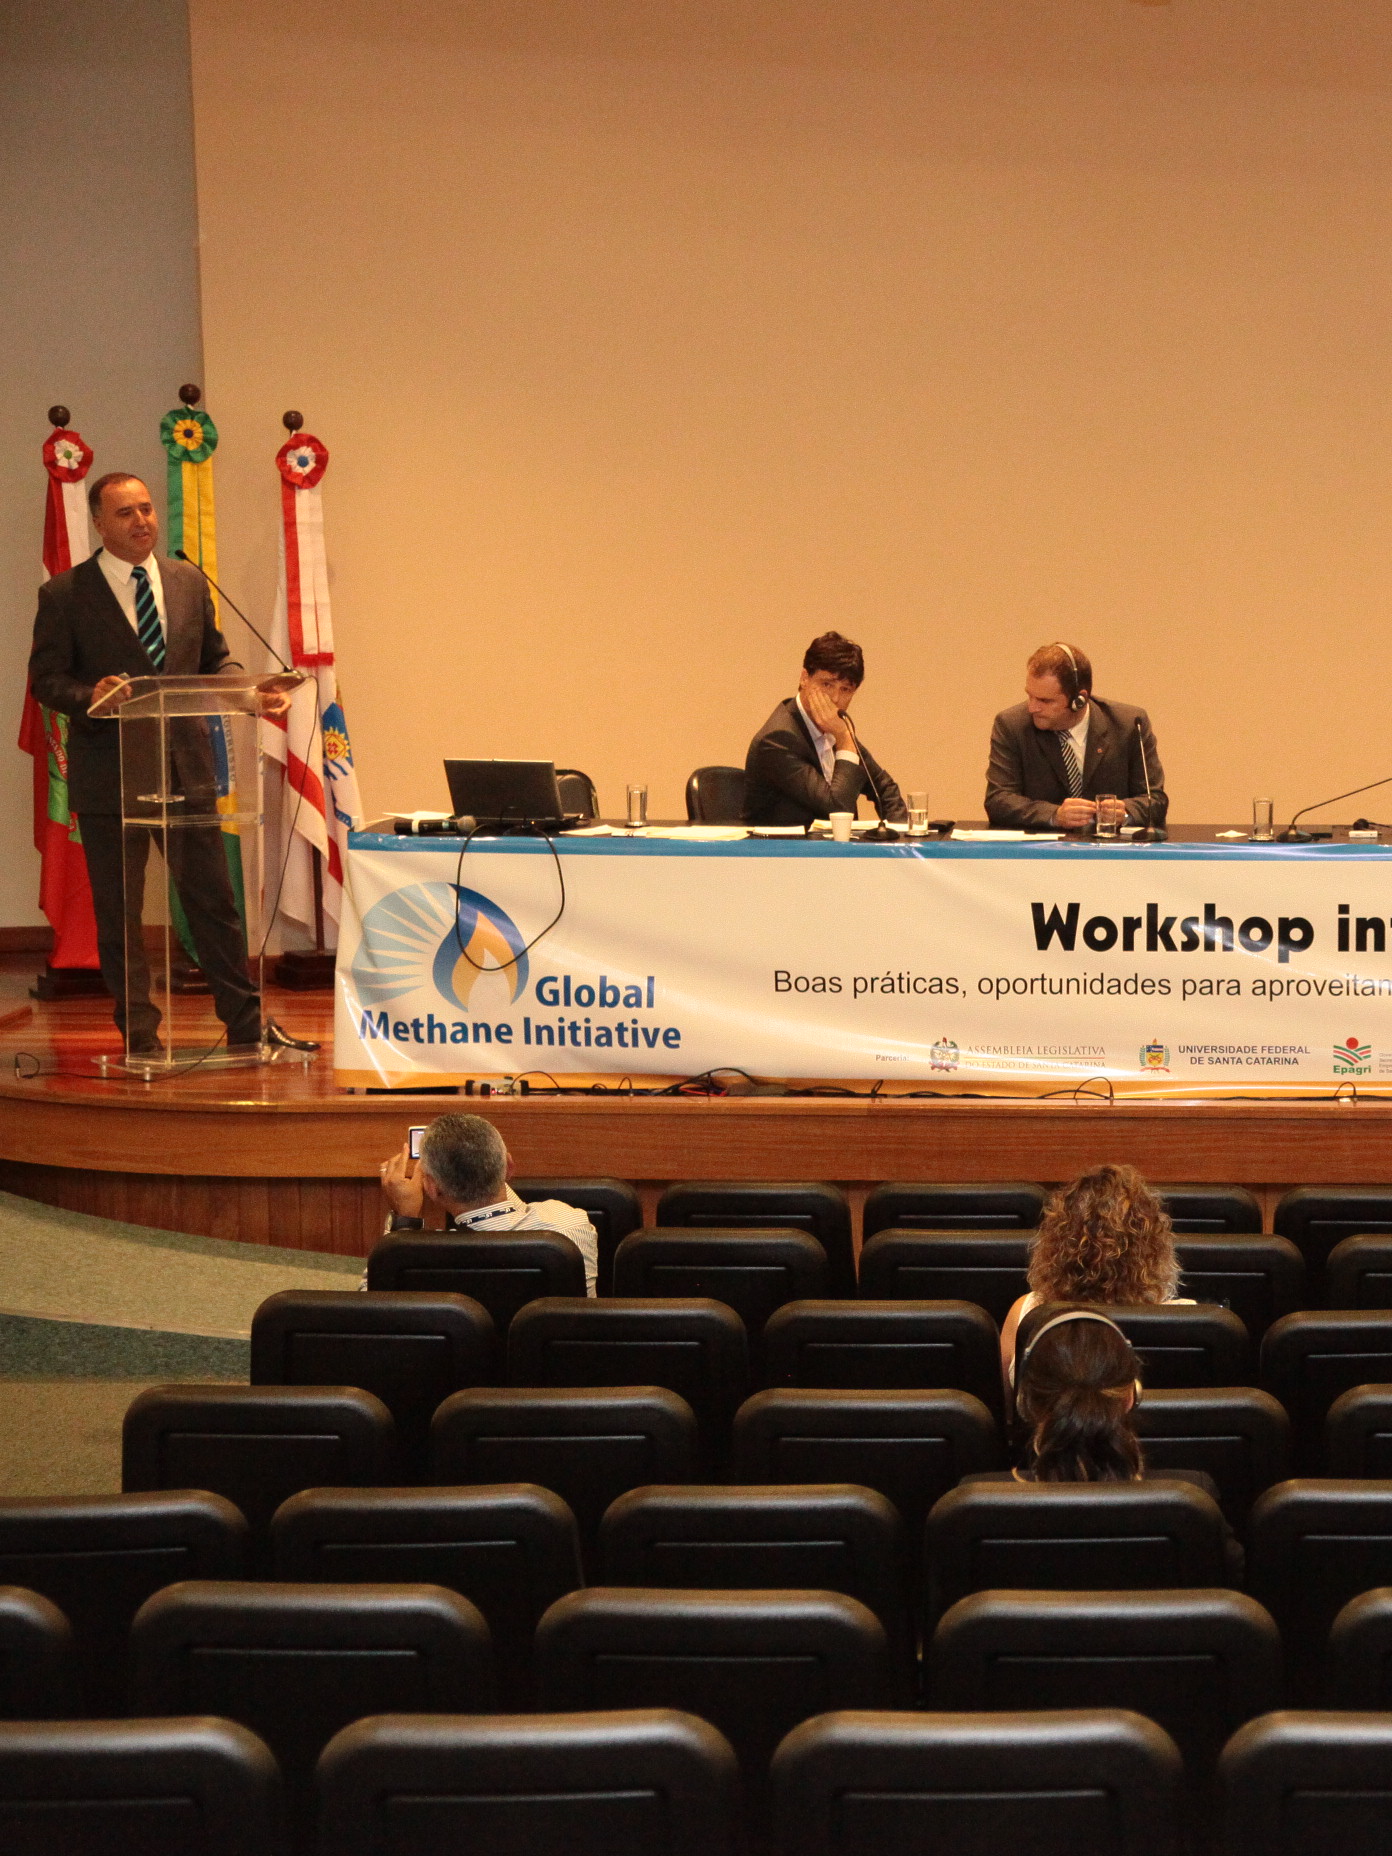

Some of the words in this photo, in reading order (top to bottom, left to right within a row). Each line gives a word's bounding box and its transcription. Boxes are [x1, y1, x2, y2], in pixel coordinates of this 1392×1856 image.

[1031, 902, 1314, 963] Workshop
[535, 975, 654, 1008] Global
[775, 970, 842, 993] Boas
[854, 971, 966, 999] práticas,
[978, 972, 1171, 1000] oportunidades
[1182, 979, 1241, 1001] para
[358, 1011, 513, 1045] Methane
[524, 1017, 681, 1049] Initiative
[967, 1046, 1033, 1055] ASSEMBLEIA
[1037, 1045, 1105, 1055] LEGISLATIVA
[1178, 1045, 1257, 1054] UNIVERSIDADE
[1261, 1045, 1310, 1054] FEDERAL
[1190, 1057, 1204, 1065] DE
[1208, 1056, 1243, 1065] SANTA
[1246, 1057, 1299, 1065] CATARINA
[1333, 1065, 1371, 1076] Epagri
